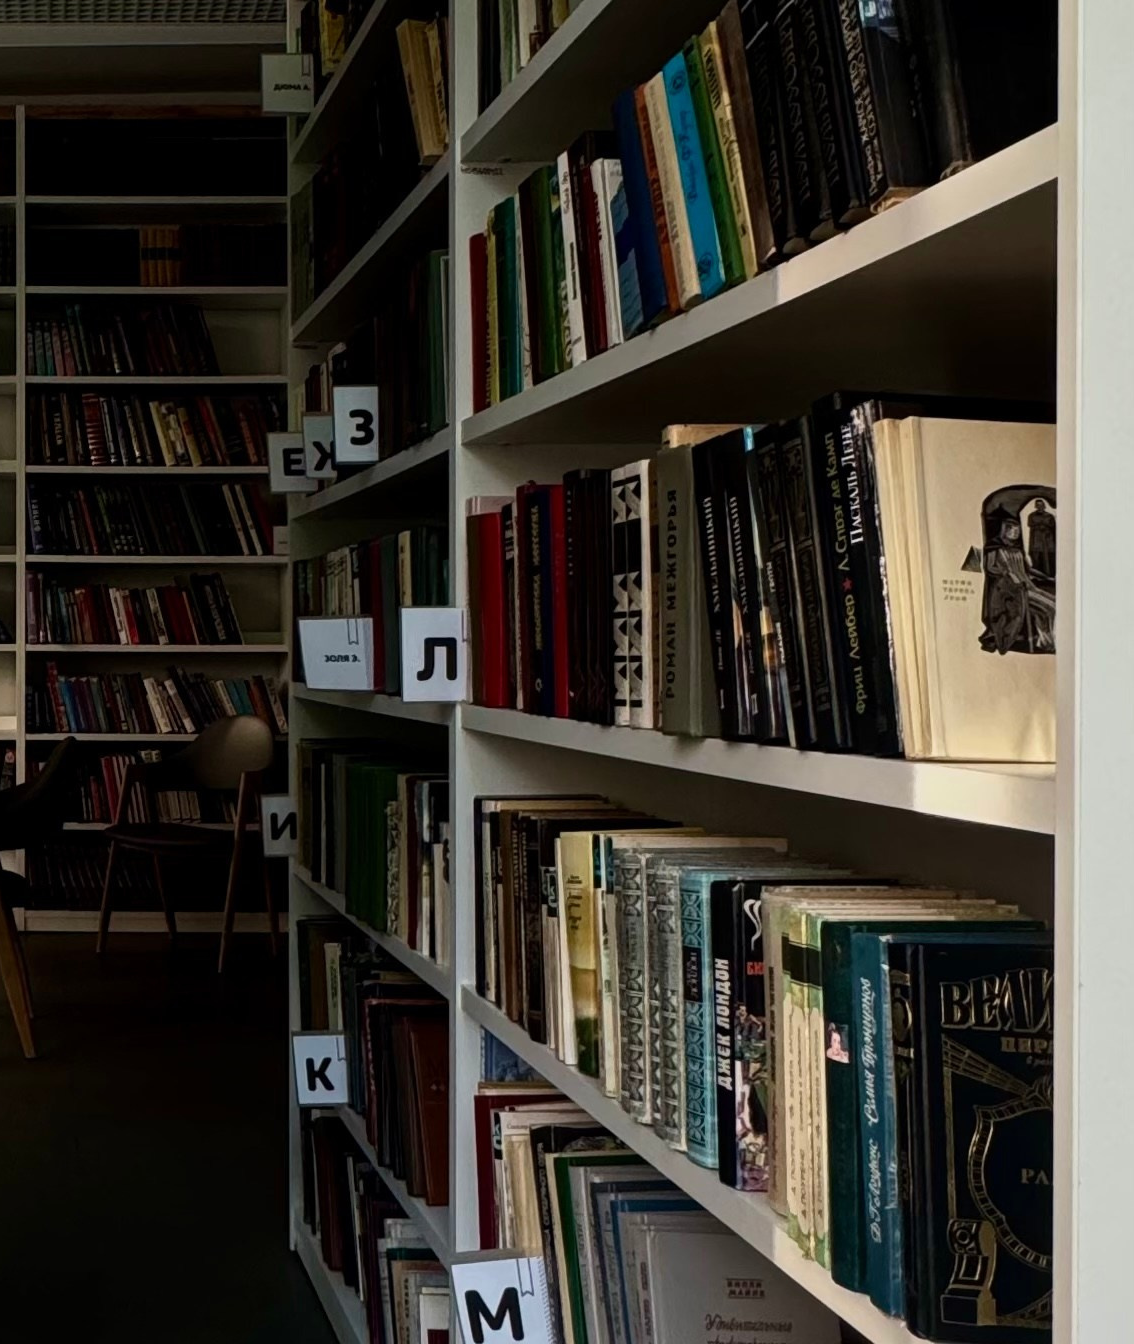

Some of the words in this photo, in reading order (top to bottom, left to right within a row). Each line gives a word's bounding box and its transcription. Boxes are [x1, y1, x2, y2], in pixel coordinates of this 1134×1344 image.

[273, 83, 301, 92] ДЮМА
[302, 83, 311, 91] А.
[349, 409, 374, 446] З
[284, 447, 304, 476] Е
[823, 432, 839, 477] Камп
[831, 479, 841, 499] де
[847, 470, 865, 545] ПАСКАЛЬ
[665, 488, 677, 611] МЕЖГОРЬЯ
[701, 496, 721, 614] ХМЕЛЬНИЦКИЙ
[728, 496, 750, 615] ХМЕЛЬНИЦКИЙ
[843, 594, 862, 660] Лейбер
[324, 654, 349, 663] ЗОЛЯ
[351, 655, 361, 663] Э.
[417, 636, 457, 681] Л
[665, 622, 677, 700] РОМАН
[855, 666, 868, 715] Фриц
[270, 812, 297, 843] И
[713, 957, 732, 1026] ЛОНДОН
[306, 1058, 334, 1092] К
[716, 1027, 735, 1091] ДЖЕК
[465, 1286, 524, 1344] М
[704, 1313, 794, 1333] Удивительные
